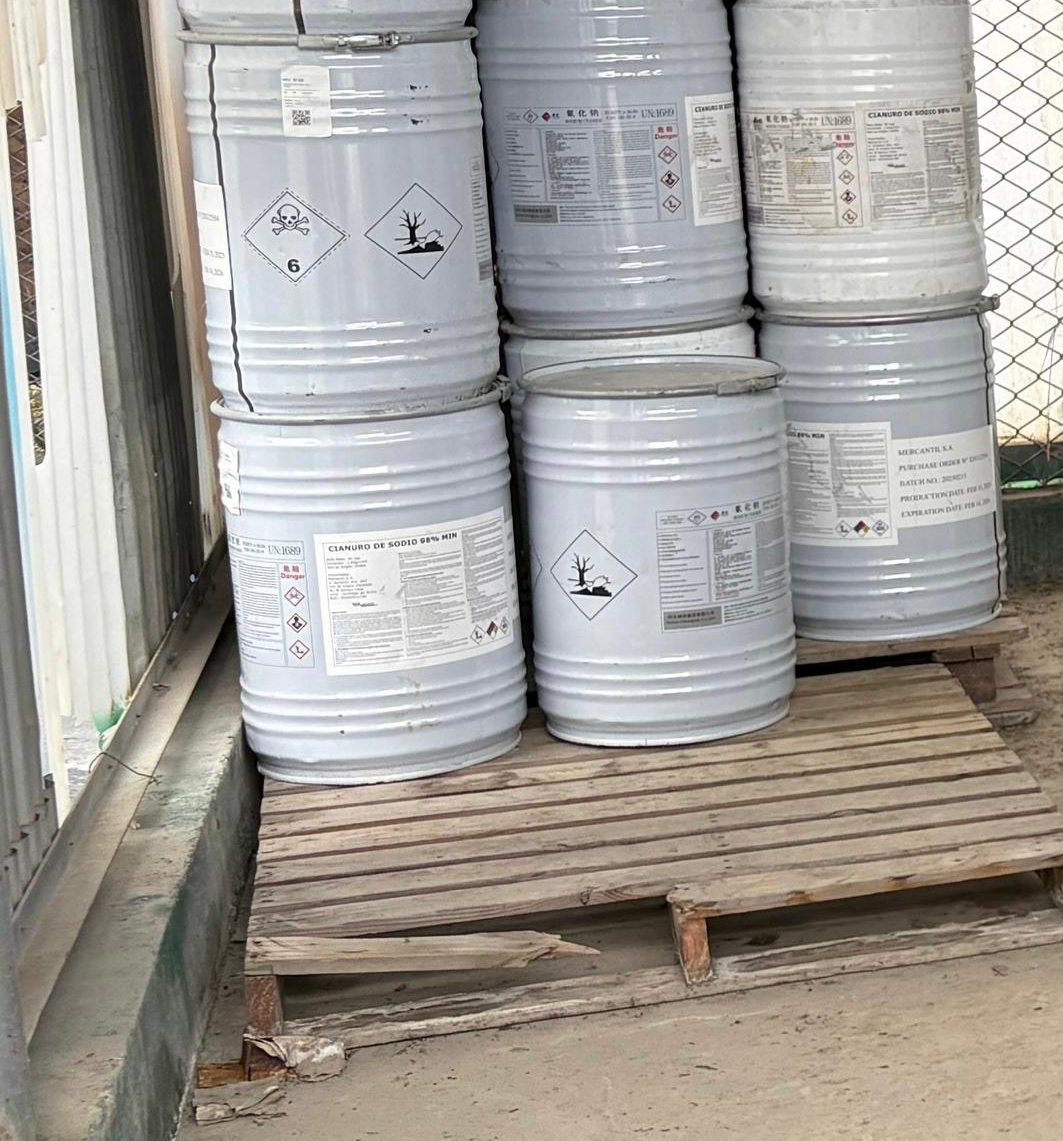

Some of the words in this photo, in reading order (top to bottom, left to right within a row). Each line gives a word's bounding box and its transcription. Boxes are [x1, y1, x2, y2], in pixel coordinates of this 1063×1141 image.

[868, 111, 902, 119] CIANURO
[821, 115, 852, 127] UN:1689
[287, 259, 300, 273] 6
[898, 446, 940, 456] MERCANTIL
[899, 462, 938, 472] PURCHASE
[900, 479, 925, 487] BATCH
[901, 508, 945, 518] EXPIRATION
[328, 543, 371, 552] CIANURO
[388, 538, 417, 548] SODIO
[420, 534, 440, 545] 98%
[442, 532, 458, 540] MIN
[268, 544, 301, 556] UN:1689
[281, 572, 305, 580] Danger
